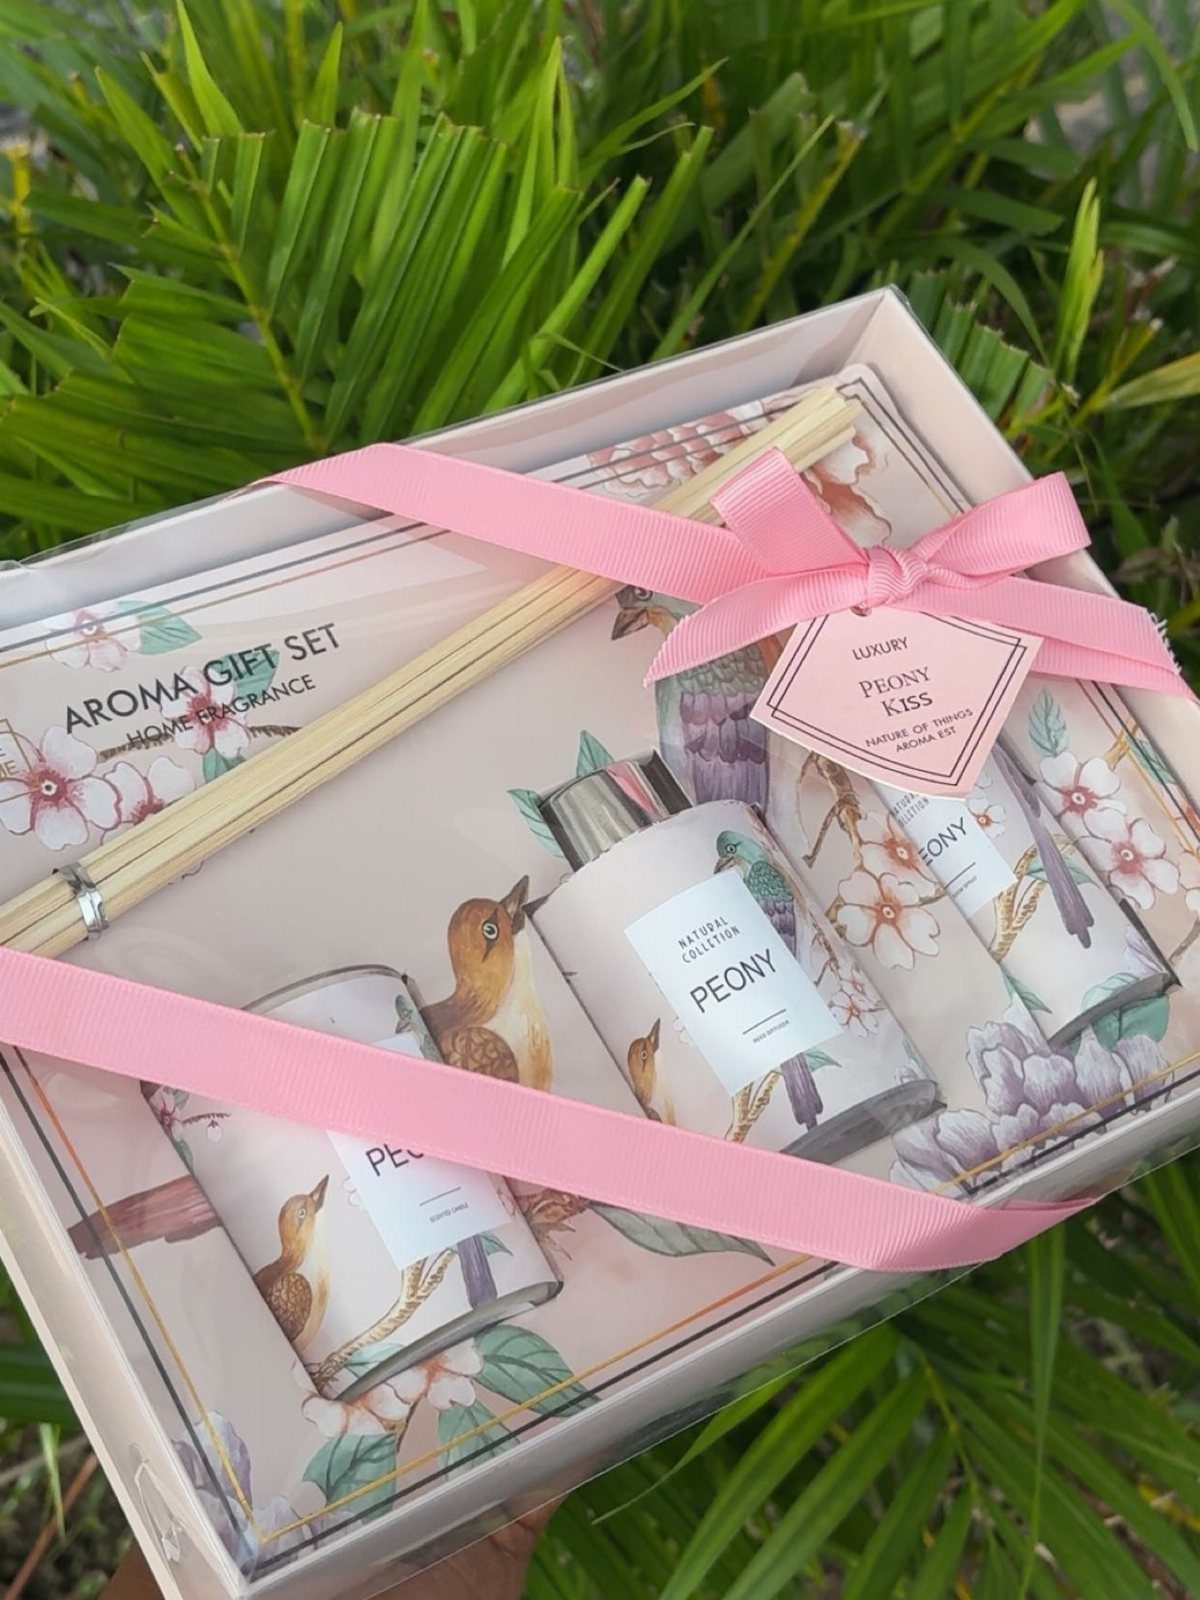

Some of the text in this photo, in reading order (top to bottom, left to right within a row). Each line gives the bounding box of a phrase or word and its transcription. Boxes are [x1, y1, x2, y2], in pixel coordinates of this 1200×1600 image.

[852, 636, 908, 661] LUXURY
[66, 623, 340, 734] AROMA GIFT SET
[858, 666, 930, 698] PEONY
[126, 673, 317, 747] HOME FRAGRANCE
[881, 691, 933, 717] KISS
[865, 708, 973, 747] NATURE OF THINGS
[896, 725, 957, 753] AROMA EST
[678, 916, 728, 950] NATURAL
[682, 925, 740, 963] COLLETION
[689, 948, 777, 1014] PEONY
